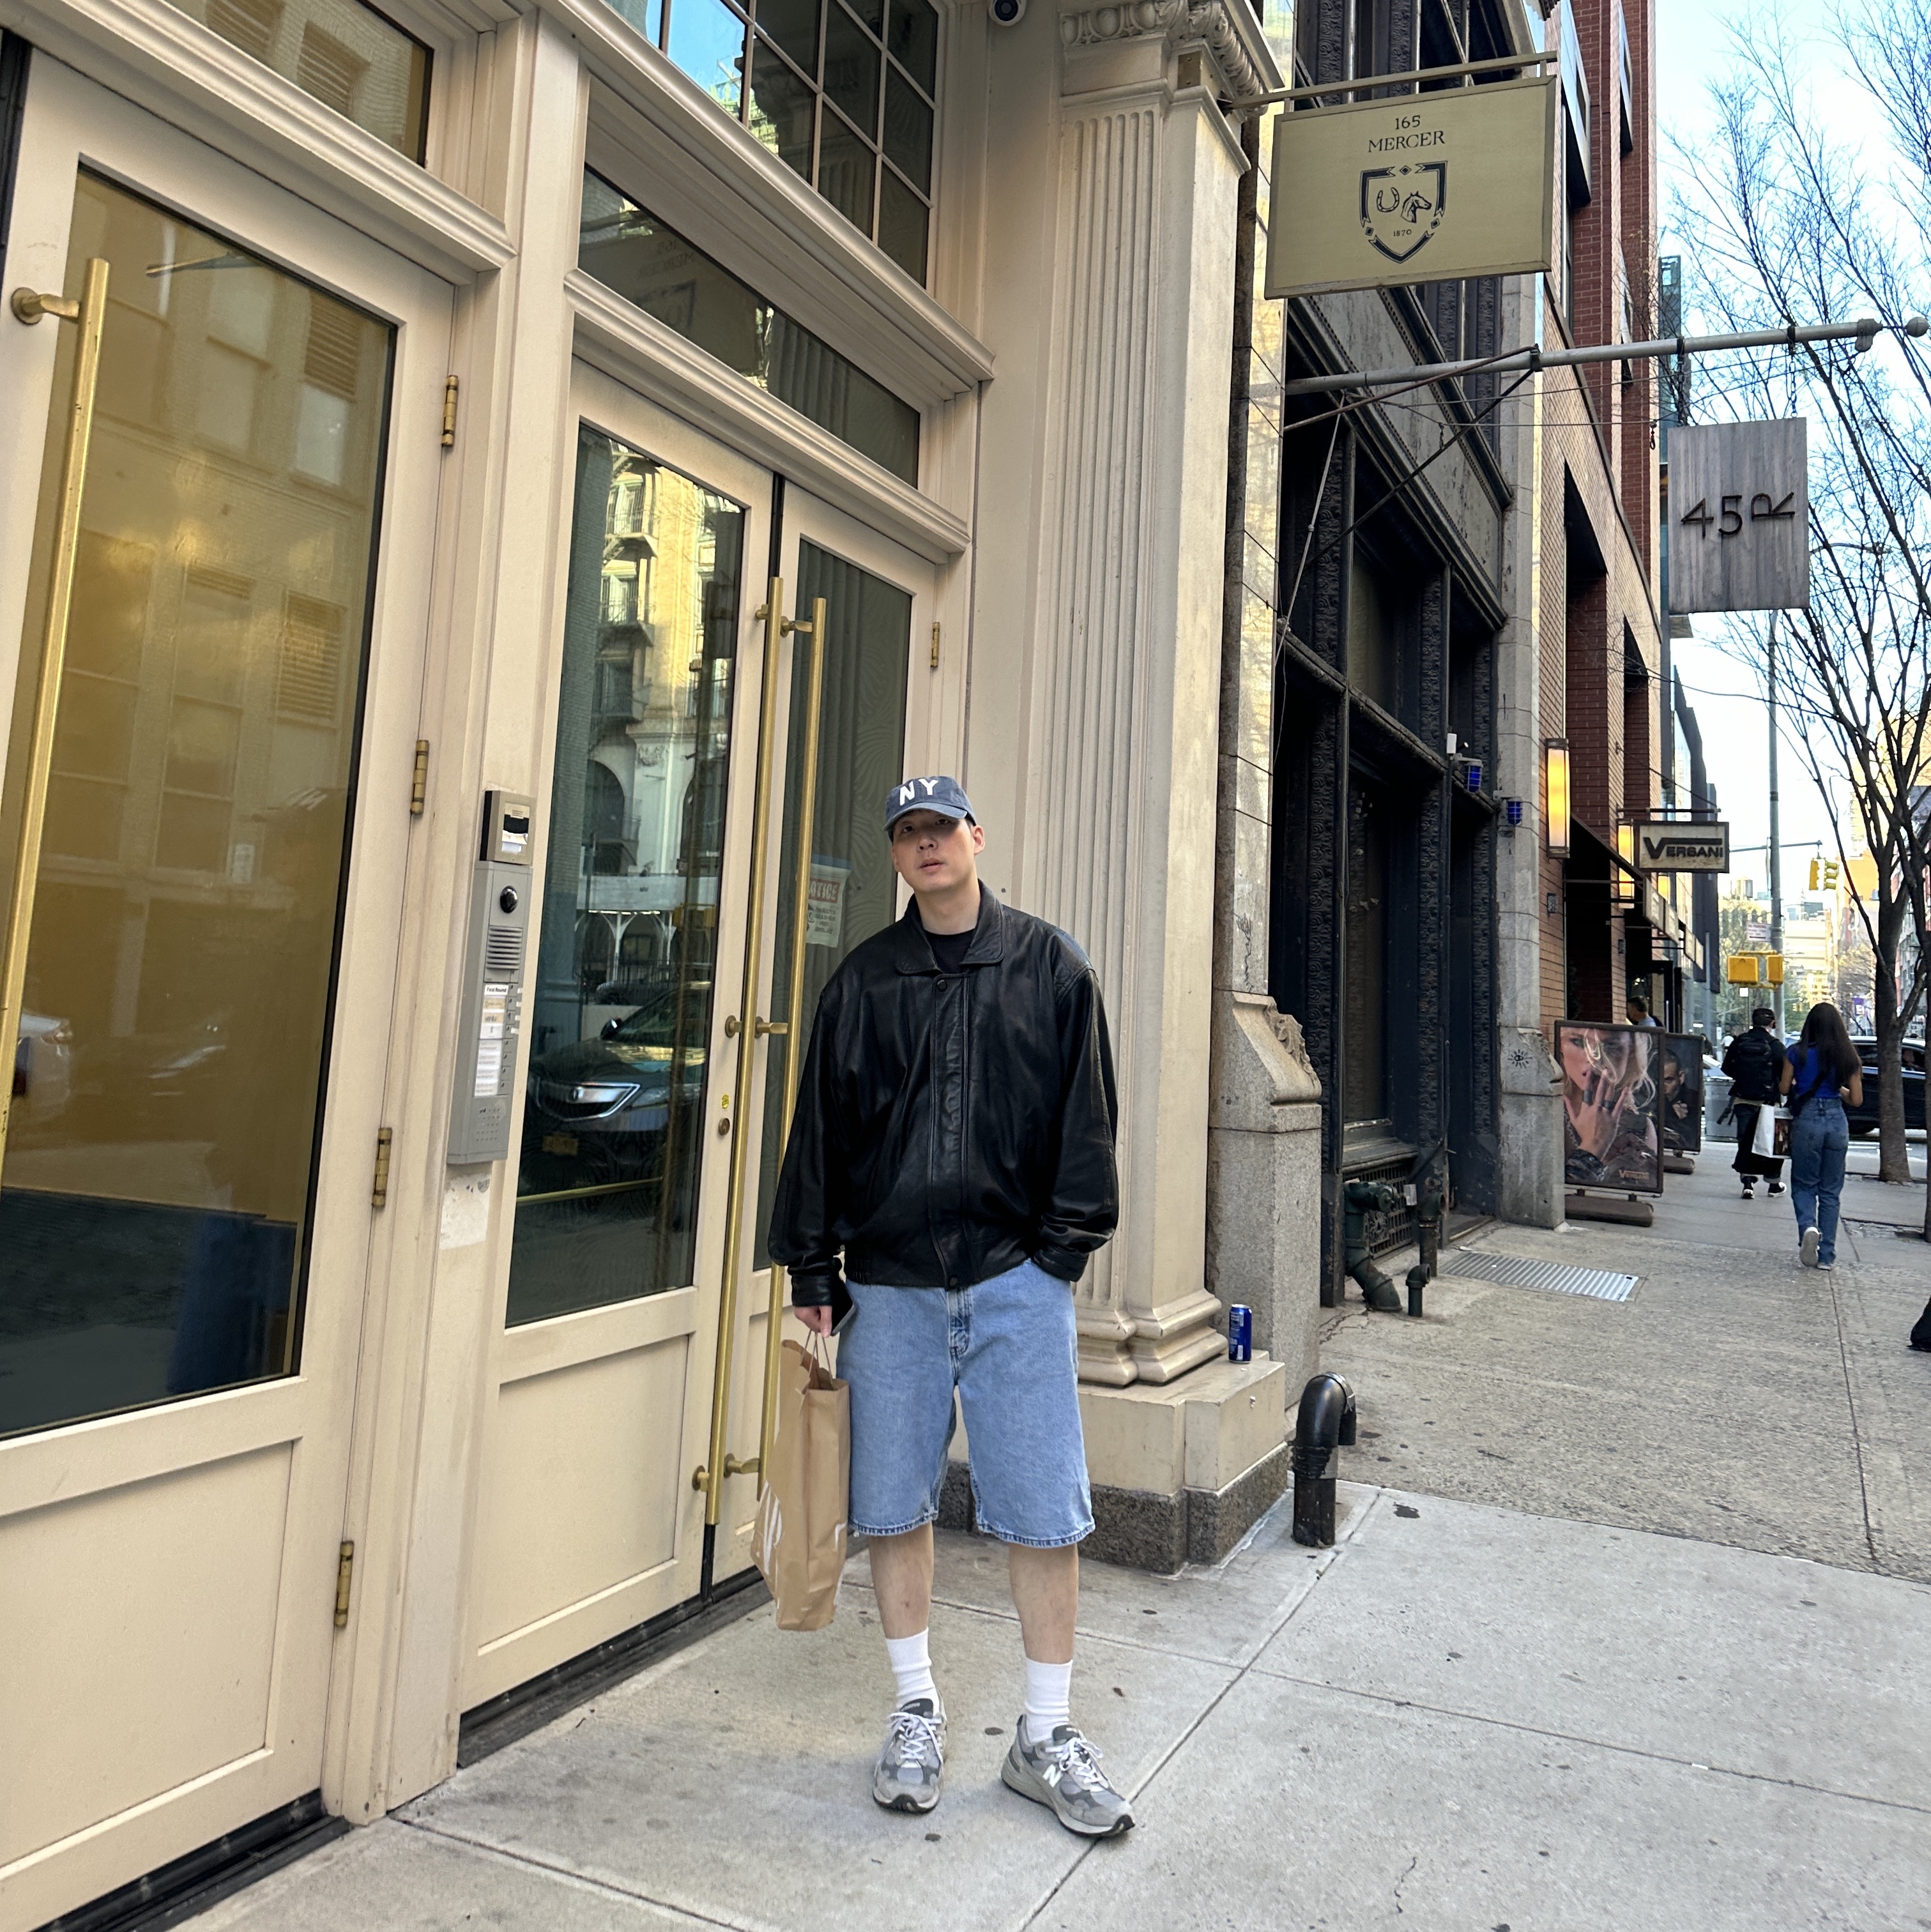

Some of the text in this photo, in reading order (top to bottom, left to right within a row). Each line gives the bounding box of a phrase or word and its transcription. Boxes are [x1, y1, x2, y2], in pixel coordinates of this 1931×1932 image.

[1395, 115, 1421, 130] 165
[1368, 130, 1446, 153] MERCER
[1393, 229, 1412, 237] 1870
[1680, 492, 1796, 540] 45R
[899, 779, 938, 806] NY
[809, 880, 839, 901] OTICE
